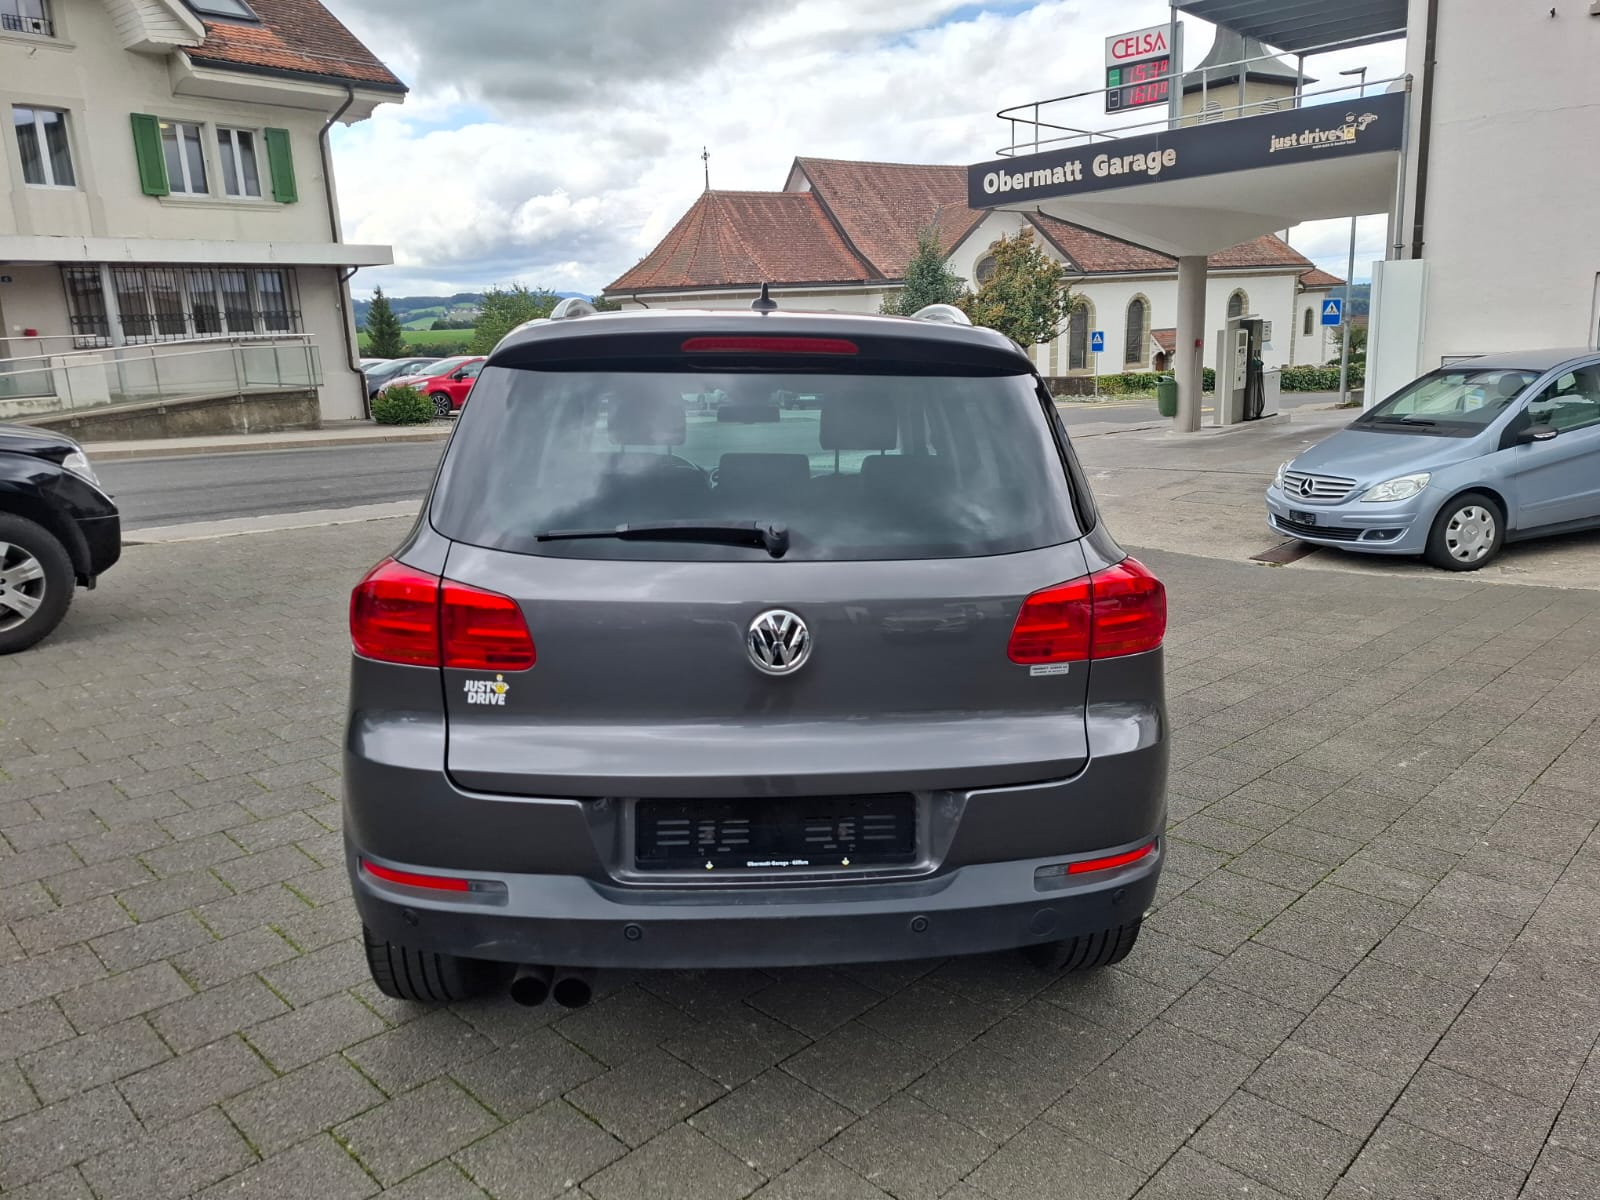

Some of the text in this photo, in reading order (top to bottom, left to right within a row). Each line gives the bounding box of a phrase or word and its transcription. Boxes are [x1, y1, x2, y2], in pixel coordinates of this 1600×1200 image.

[1112, 30, 1167, 59] CELSA
[1269, 133, 1297, 153] just
[1299, 128, 1337, 145] drive
[983, 148, 1177, 194] Obermatt Garage
[463, 680, 493, 692] JUST
[467, 692, 506, 705] DRIVE
